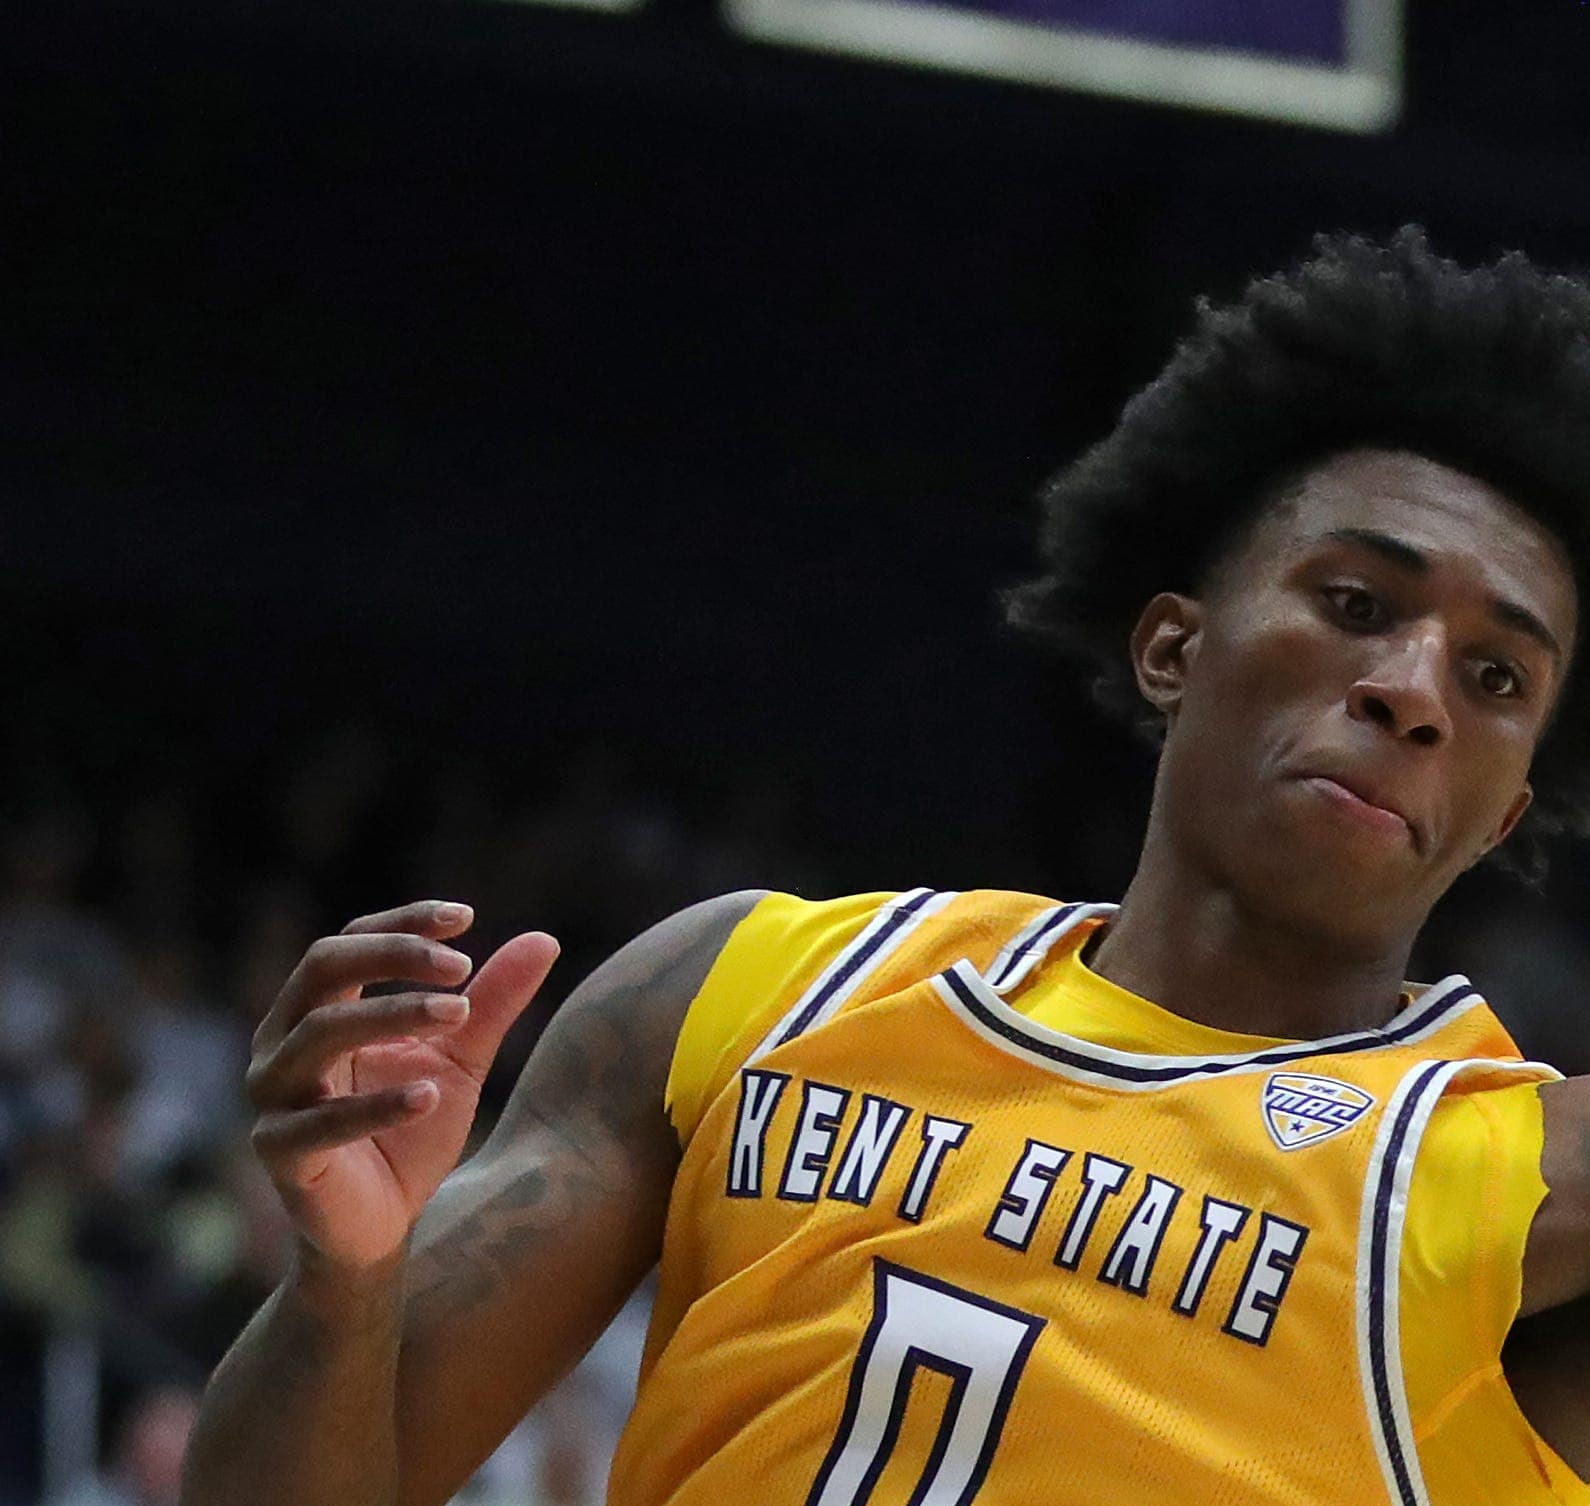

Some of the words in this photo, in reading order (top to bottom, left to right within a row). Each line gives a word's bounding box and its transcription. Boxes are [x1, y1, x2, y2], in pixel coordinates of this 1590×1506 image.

[1265, 1087, 1364, 1126] MAC
[726, 1067, 973, 1226] KENT
[984, 1138, 1311, 1348] STATE
